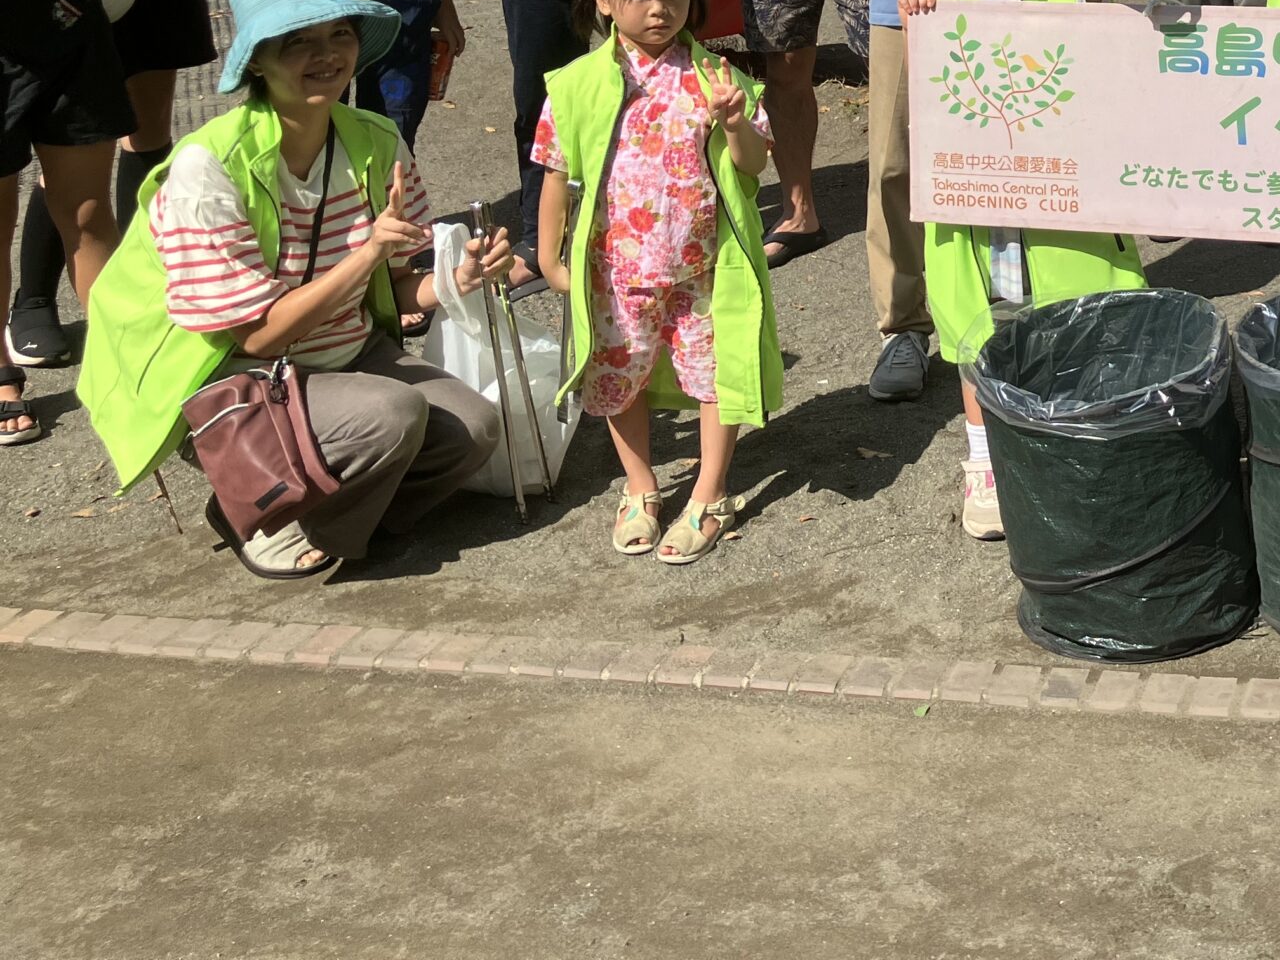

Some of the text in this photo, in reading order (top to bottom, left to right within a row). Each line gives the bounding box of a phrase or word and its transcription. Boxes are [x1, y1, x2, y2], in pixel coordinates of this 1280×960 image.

[933, 152, 1078, 175] 高島中央公園愛護会
[932, 178, 1079, 197] Takashima Central Park
[933, 193, 1079, 213] GARDENING CLUB
